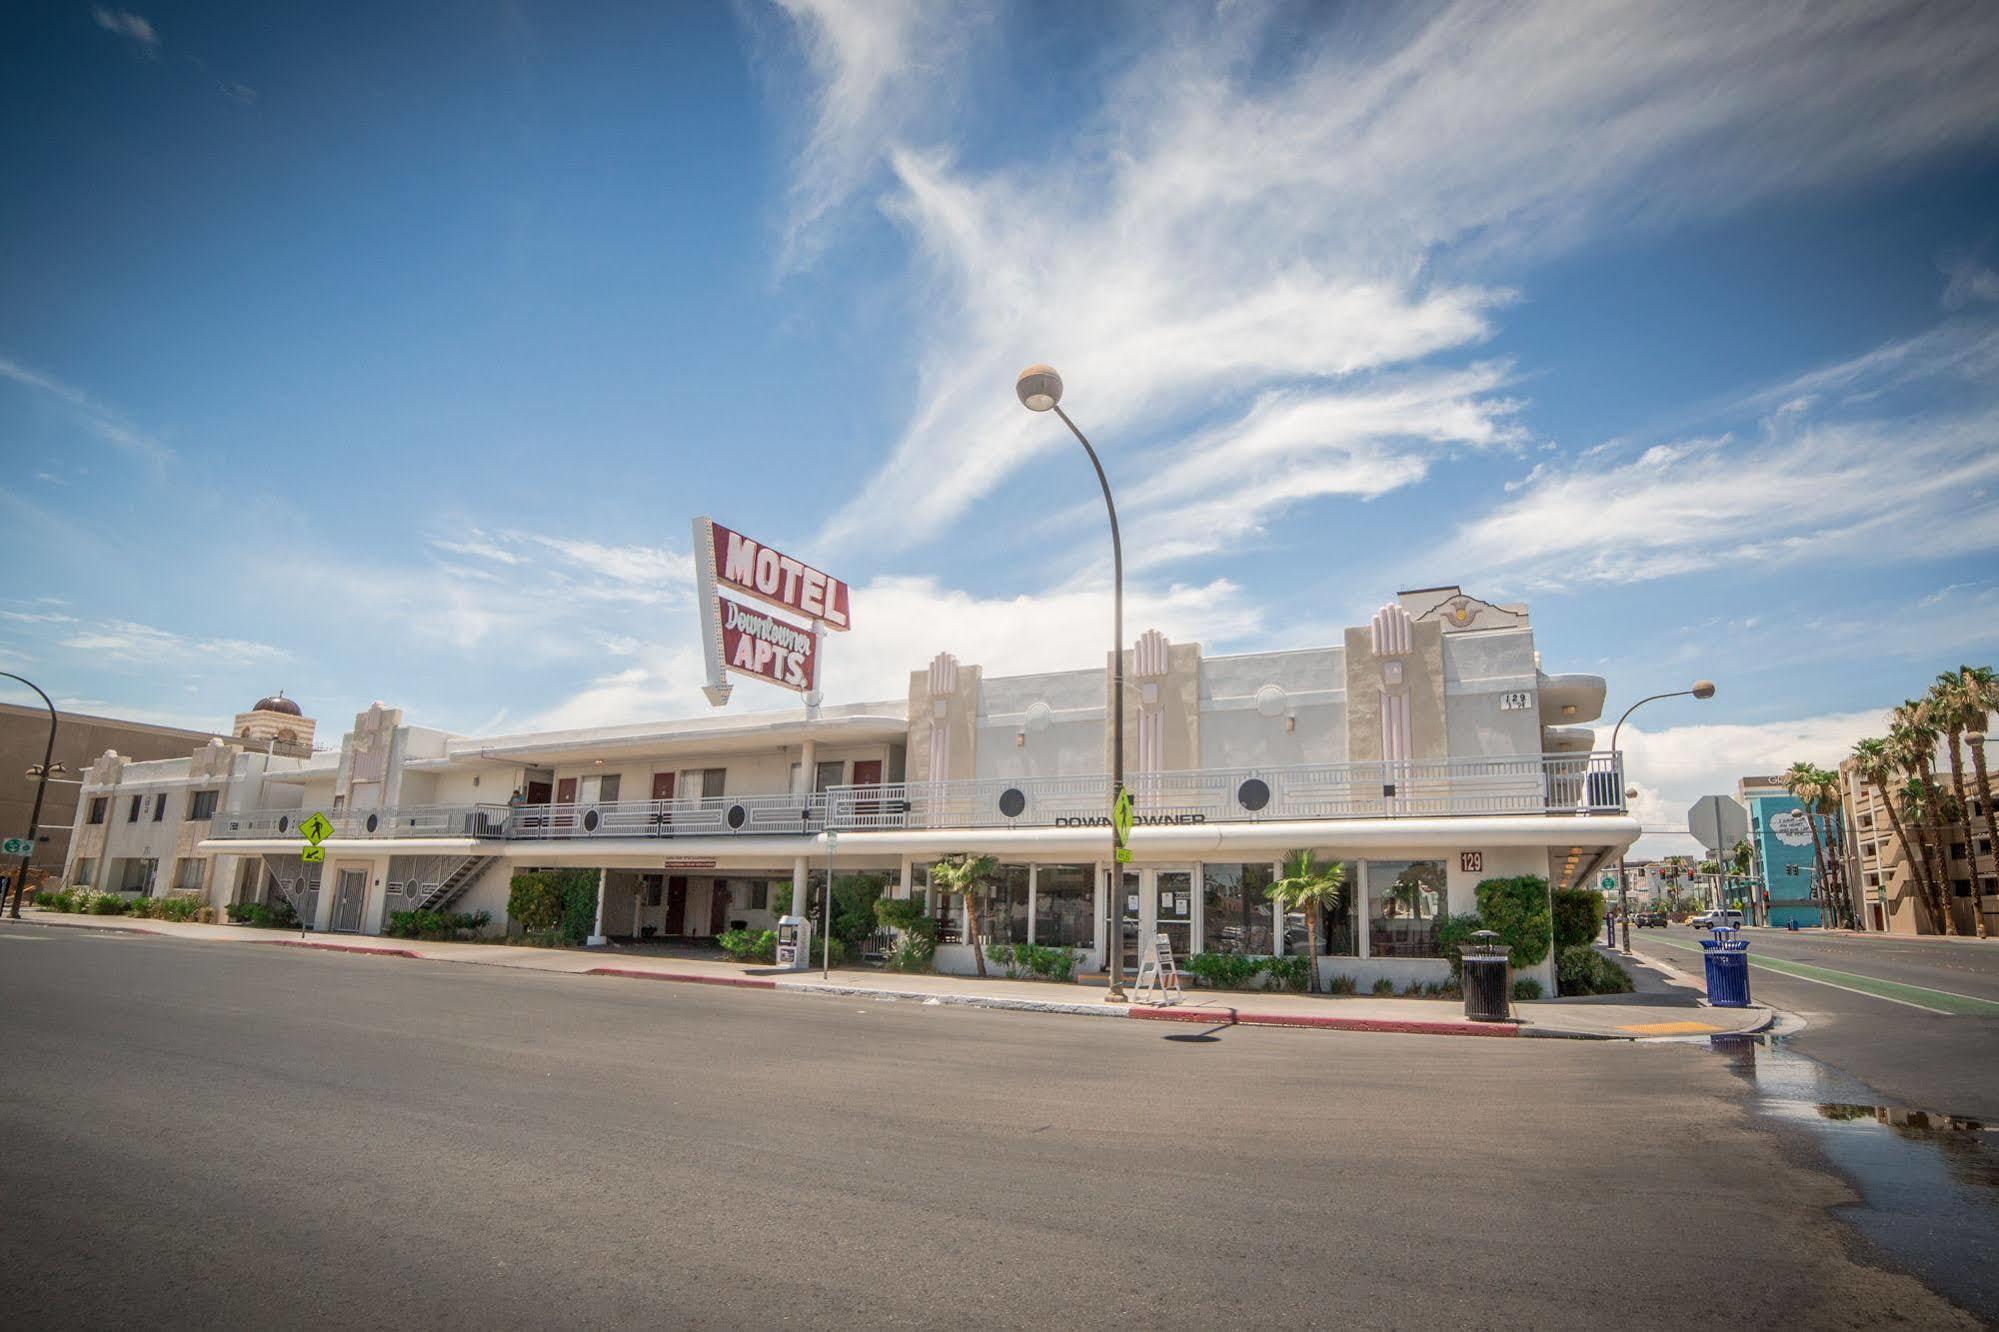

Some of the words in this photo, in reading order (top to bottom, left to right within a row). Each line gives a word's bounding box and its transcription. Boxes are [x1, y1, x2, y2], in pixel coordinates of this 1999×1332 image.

[725, 531, 847, 626] MOTEL
[725, 600, 811, 656] Downtowner
[1506, 693, 1526, 703] 129
[1463, 853, 1482, 871] 129
